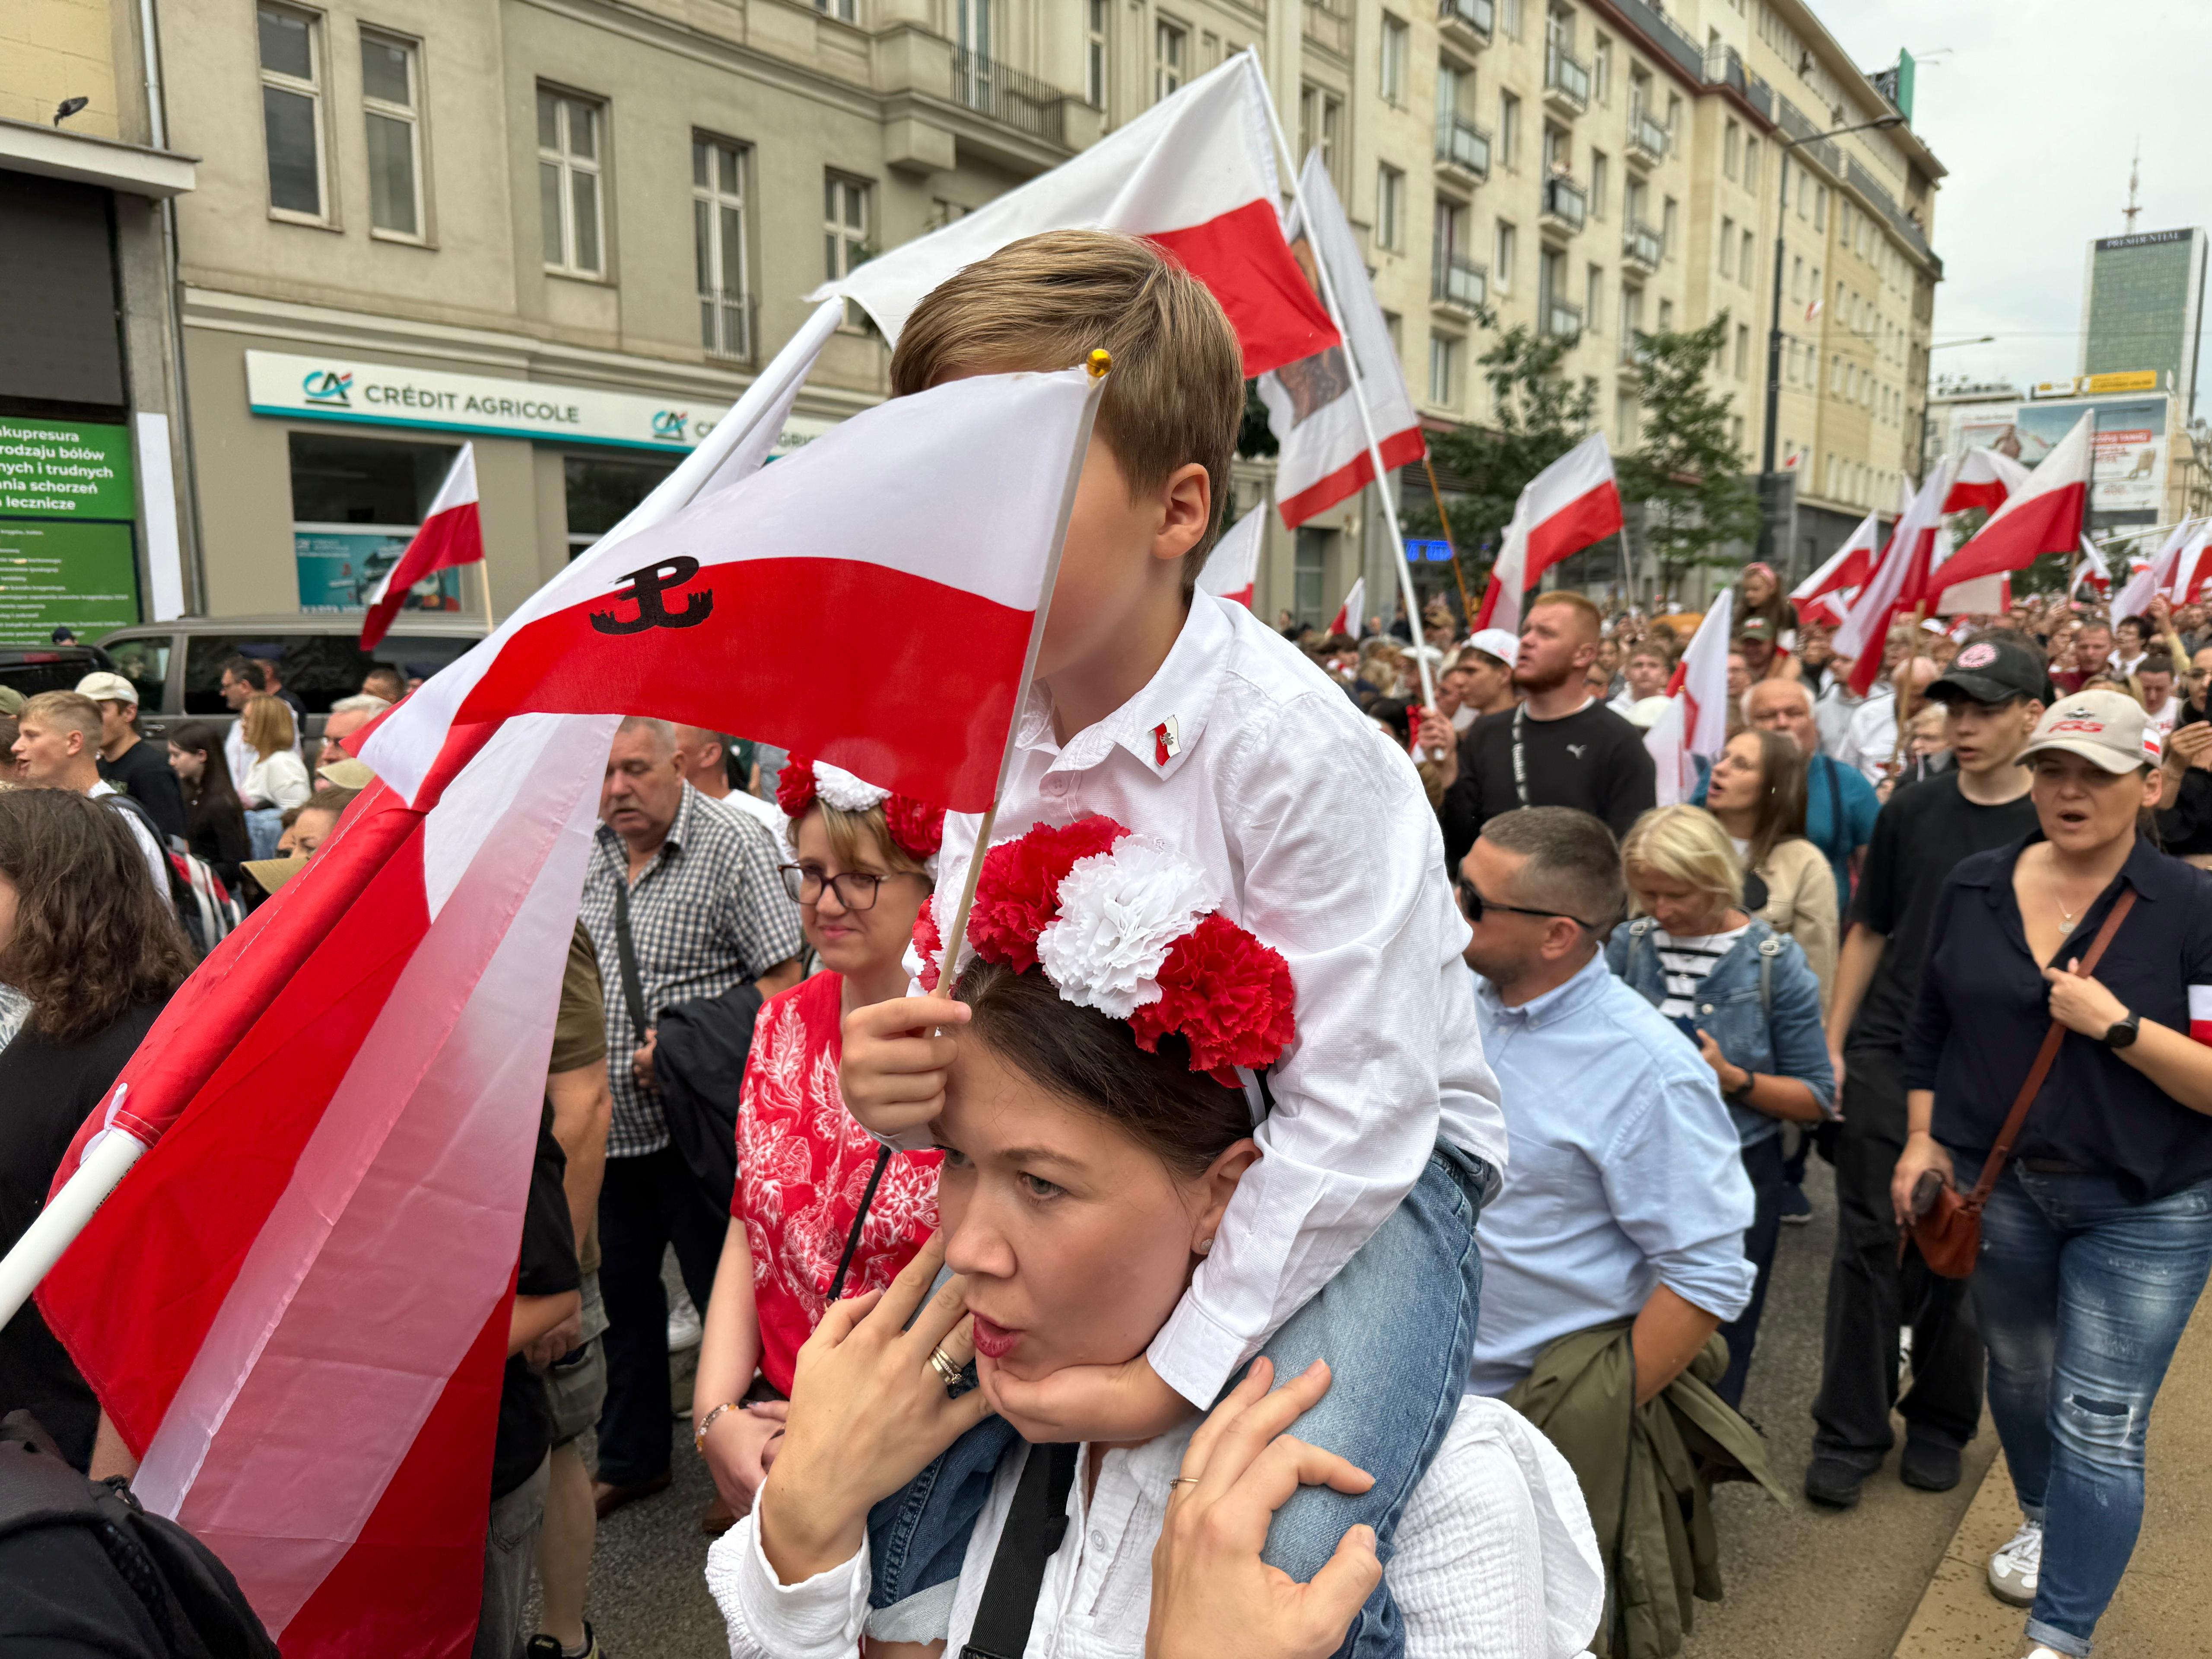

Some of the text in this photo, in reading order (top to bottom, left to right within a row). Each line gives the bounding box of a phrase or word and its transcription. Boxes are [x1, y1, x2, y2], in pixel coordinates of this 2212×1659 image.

[364, 382, 580, 423] CRÉDIT AGRICOLE
[0, 444, 105, 461] rodzaju bólów
[37, 461, 42, 474] i
[45, 464, 114, 480] trudnych
[0, 477, 98, 494] nia schorzeń
[6, 495, 76, 510] lecznicze
